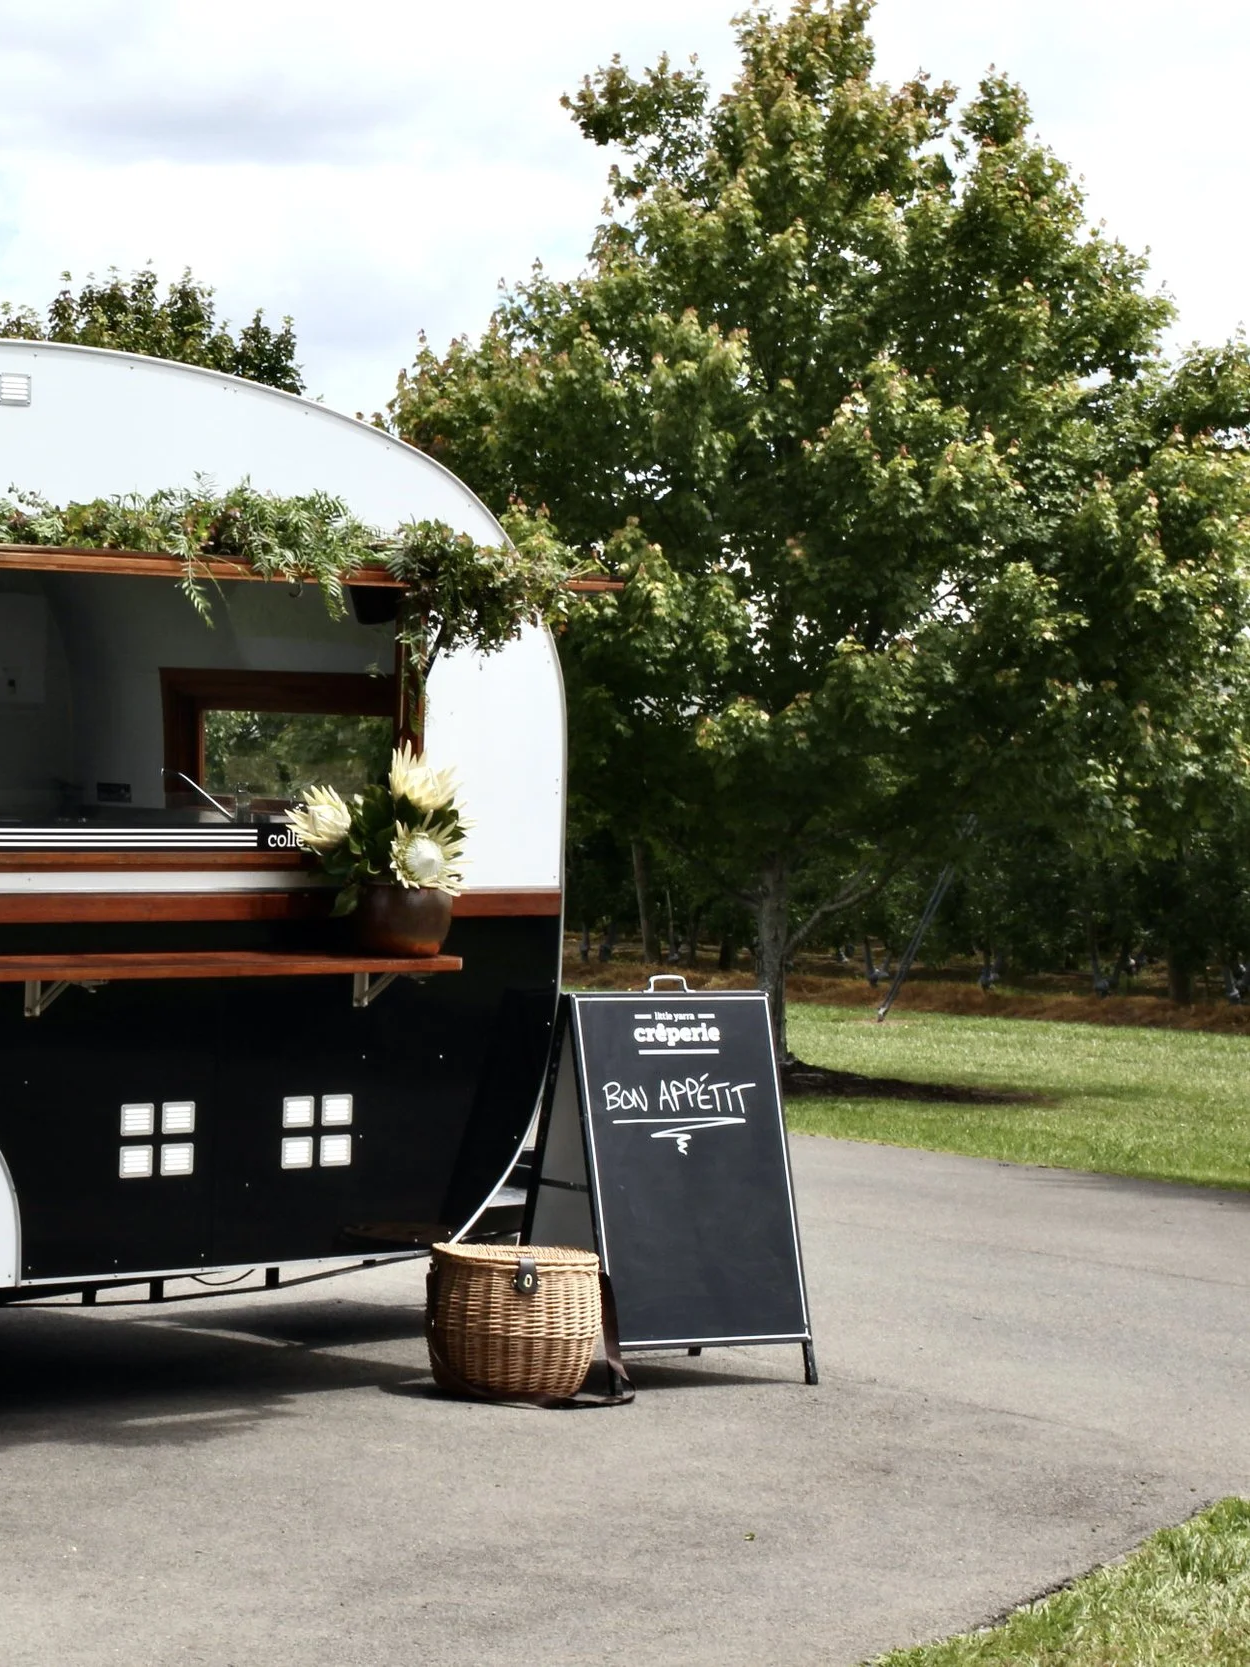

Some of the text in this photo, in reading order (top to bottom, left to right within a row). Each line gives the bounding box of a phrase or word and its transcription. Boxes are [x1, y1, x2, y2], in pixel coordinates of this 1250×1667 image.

[267, 829, 305, 848] colle
[654, 1011, 695, 1022] little yarra
[633, 1022, 720, 1046] crêperie
[602, 1073, 756, 1114] BON APPÉTIT
